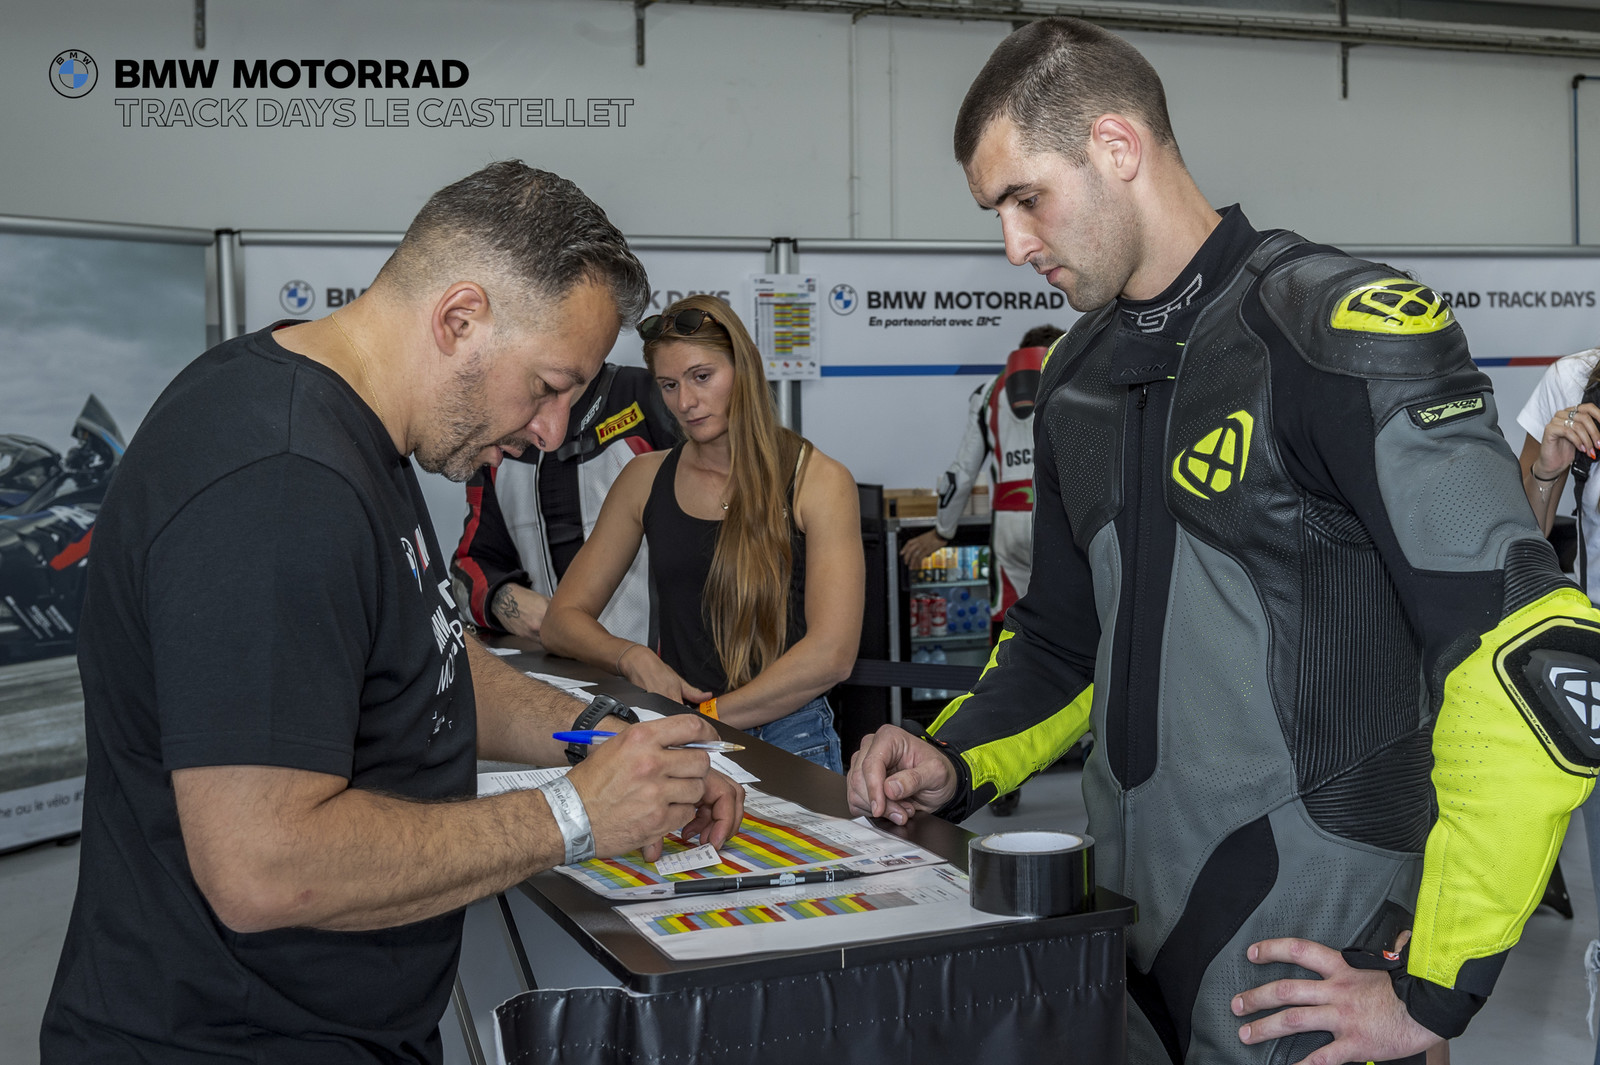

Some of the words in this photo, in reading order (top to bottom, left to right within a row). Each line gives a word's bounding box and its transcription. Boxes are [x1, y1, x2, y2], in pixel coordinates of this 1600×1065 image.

[326, 287, 369, 308] BM
[867, 291, 926, 309] BMW
[934, 291, 1064, 309] MOTORRAD
[1487, 291, 1547, 308] TRACK
[1551, 291, 1596, 307] DAYS
[869, 316, 883, 327] En
[884, 316, 947, 329] partenariat
[948, 318, 973, 327] avec
[1006, 448, 1034, 467] OSC
